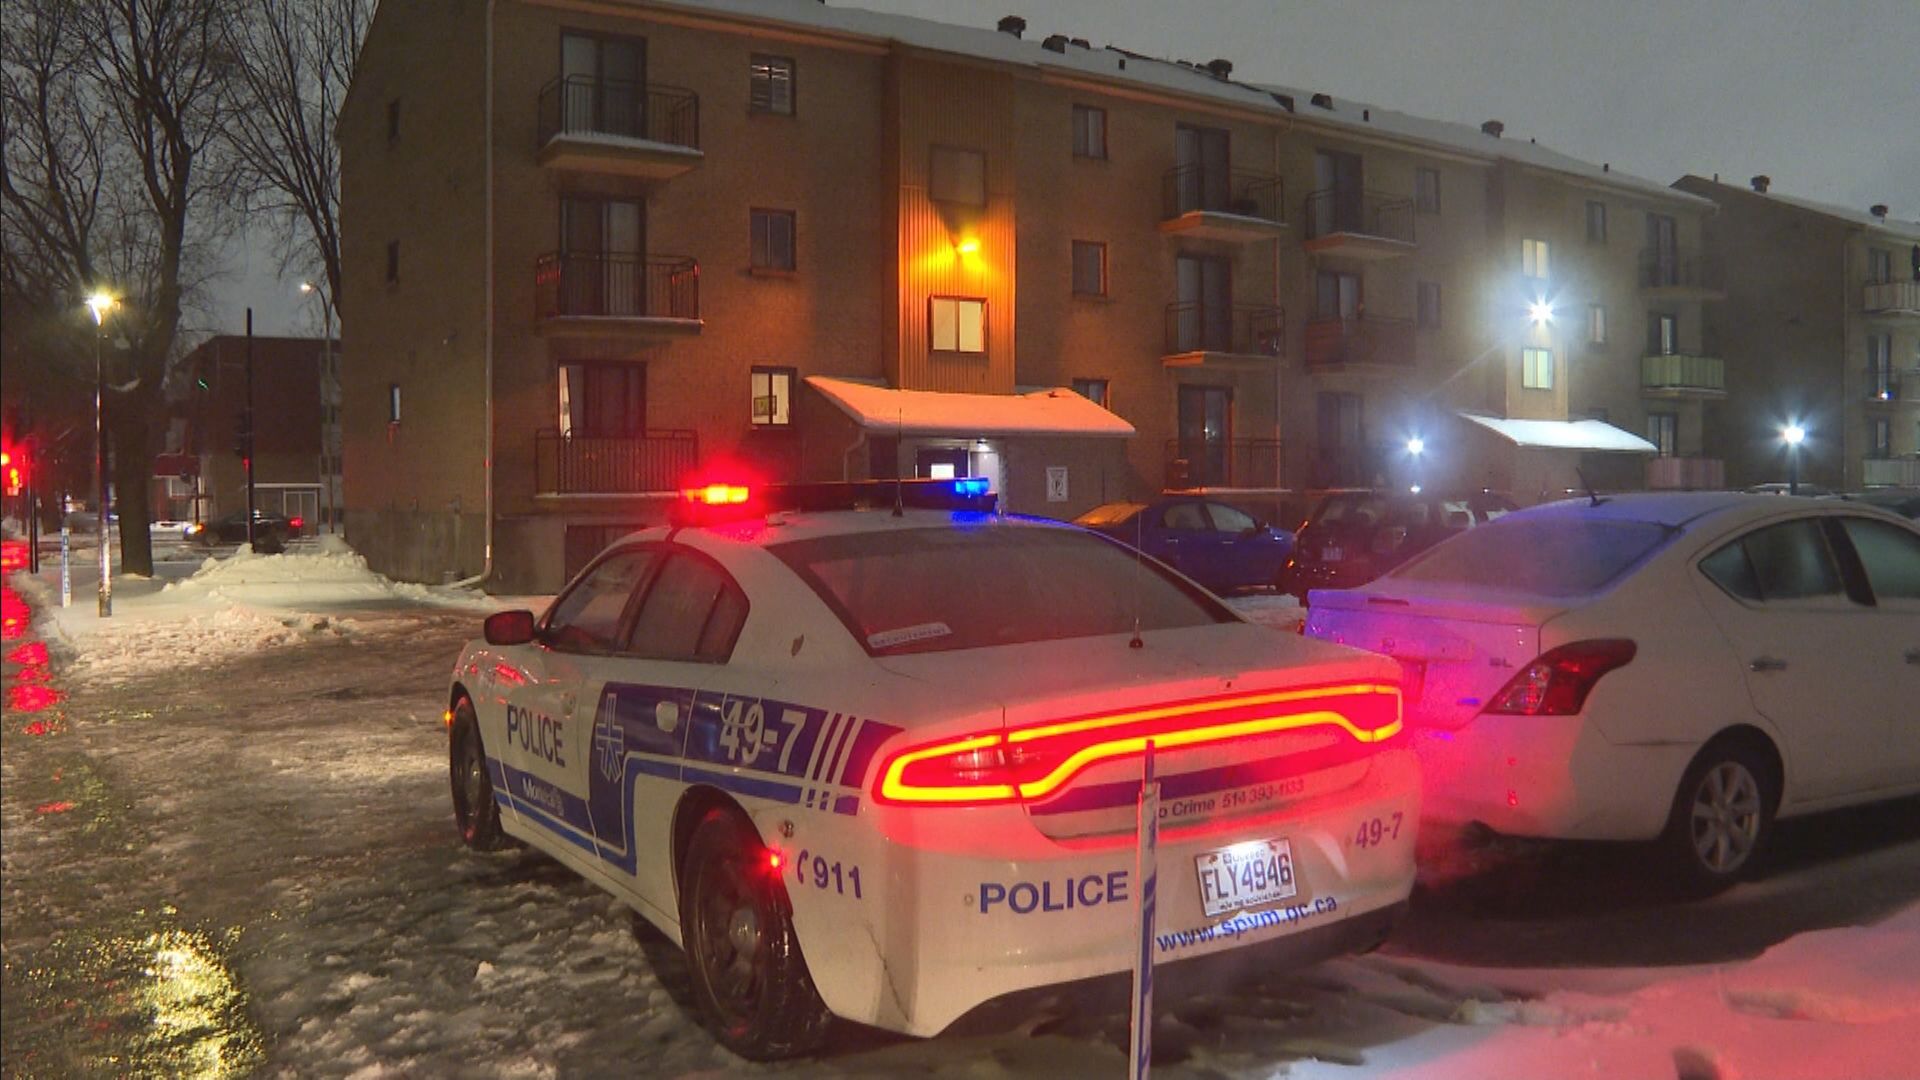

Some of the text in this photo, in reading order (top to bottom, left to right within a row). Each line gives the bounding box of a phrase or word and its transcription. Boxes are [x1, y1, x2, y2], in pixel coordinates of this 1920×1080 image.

[507, 704, 566, 768] POLICE
[719, 700, 807, 773] 49-7
[1172, 798, 1216, 817] Crime
[1356, 811, 1403, 848] 49-7
[813, 859, 862, 899] 911
[979, 870, 1129, 914] POLICE
[1201, 853, 1292, 904] FLY4946
[1156, 895, 1337, 952] www.spvm.qc.ca
